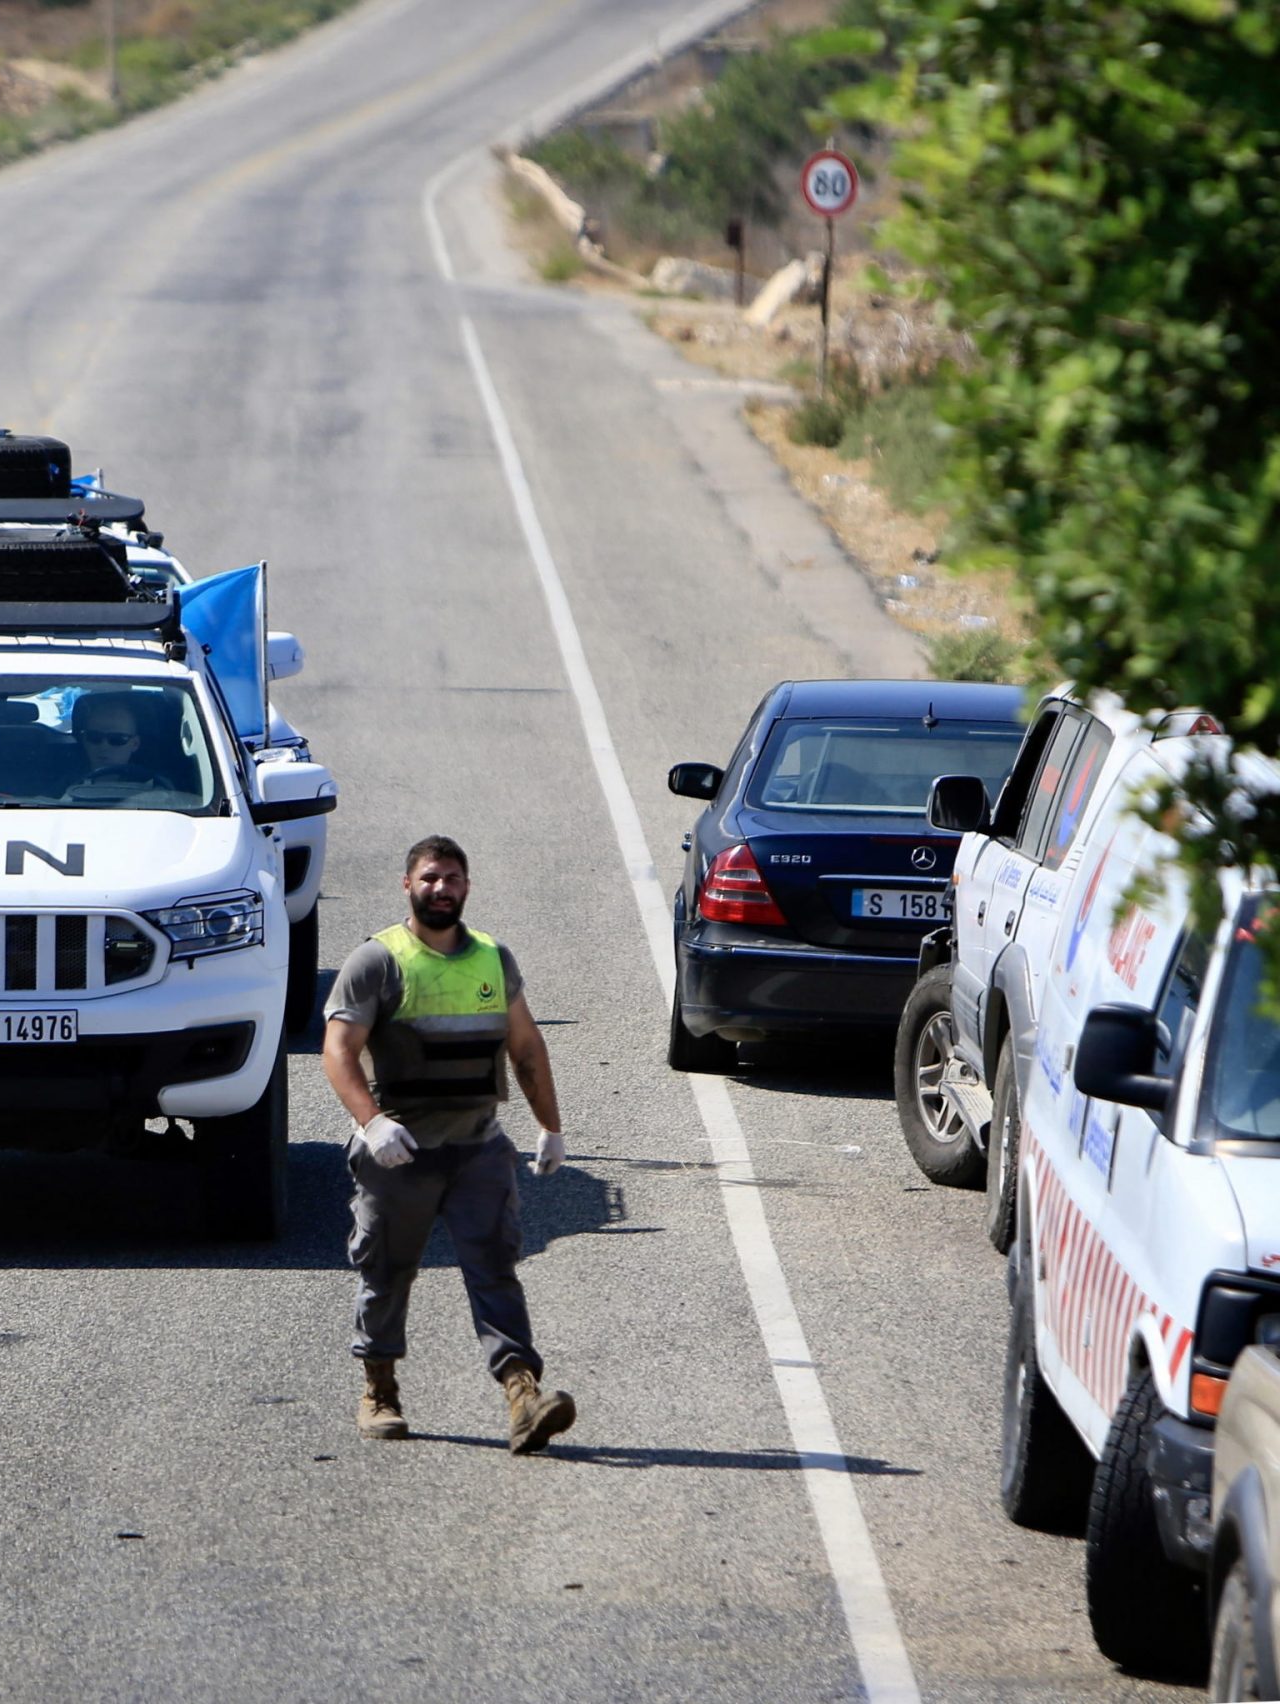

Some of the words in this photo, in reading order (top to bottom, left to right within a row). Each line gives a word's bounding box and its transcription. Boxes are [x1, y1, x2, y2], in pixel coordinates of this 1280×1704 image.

[814, 169, 847, 197] 80
[770, 854, 812, 864] E320
[870, 893, 883, 916] S
